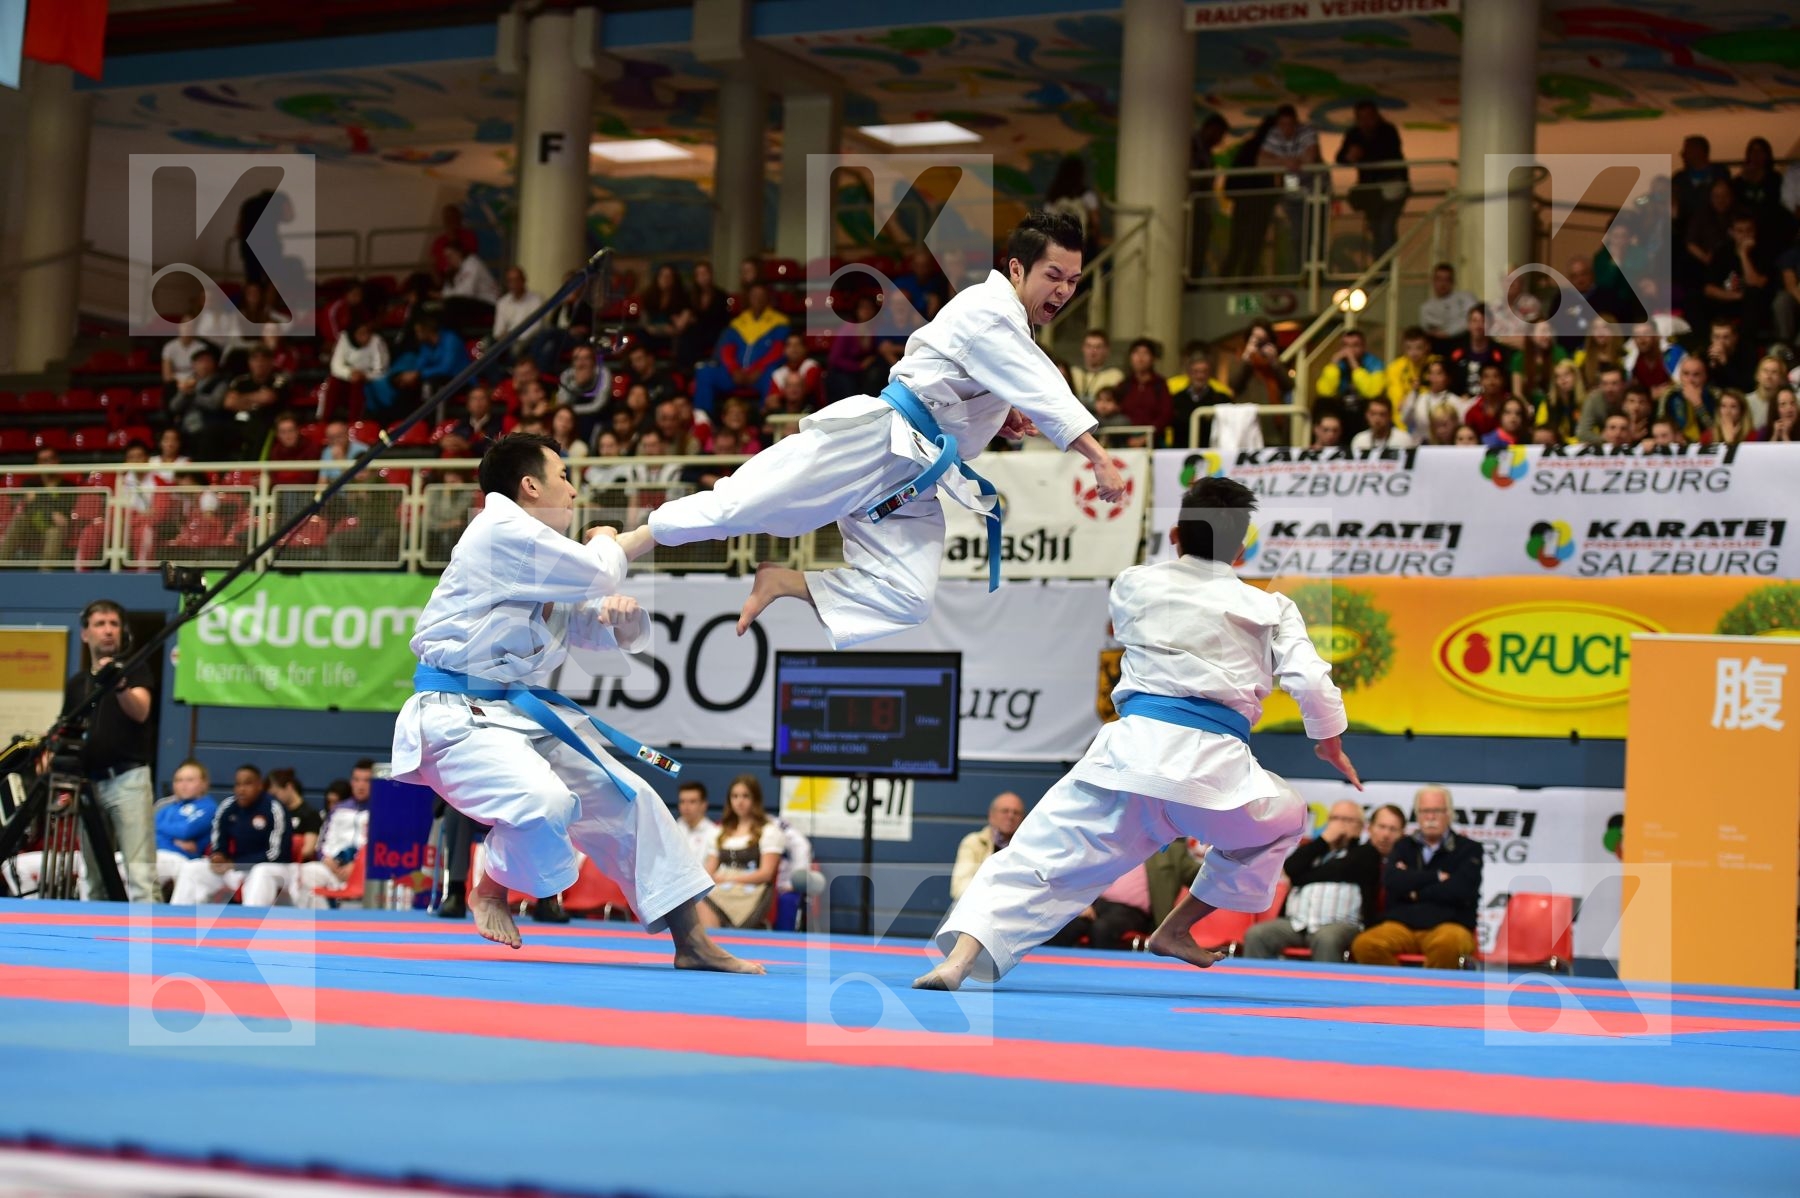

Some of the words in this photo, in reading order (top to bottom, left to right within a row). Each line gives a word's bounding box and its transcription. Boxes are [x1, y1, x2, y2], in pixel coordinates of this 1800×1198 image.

[1194, 5, 1310, 25] RAUCHEN
[1320, 0, 1449, 18] VERBOTEN
[538, 132, 564, 164] F
[1531, 468, 1732, 496] SALZBURG
[946, 526, 1077, 571] ayashi
[1258, 550, 1456, 577] SALZBURG
[1578, 550, 1780, 576] SALZBURG
[195, 658, 281, 691] learning
[287, 660, 317, 687] for
[1710, 656, 1789, 732] 腹
[373, 842, 420, 869] Red
